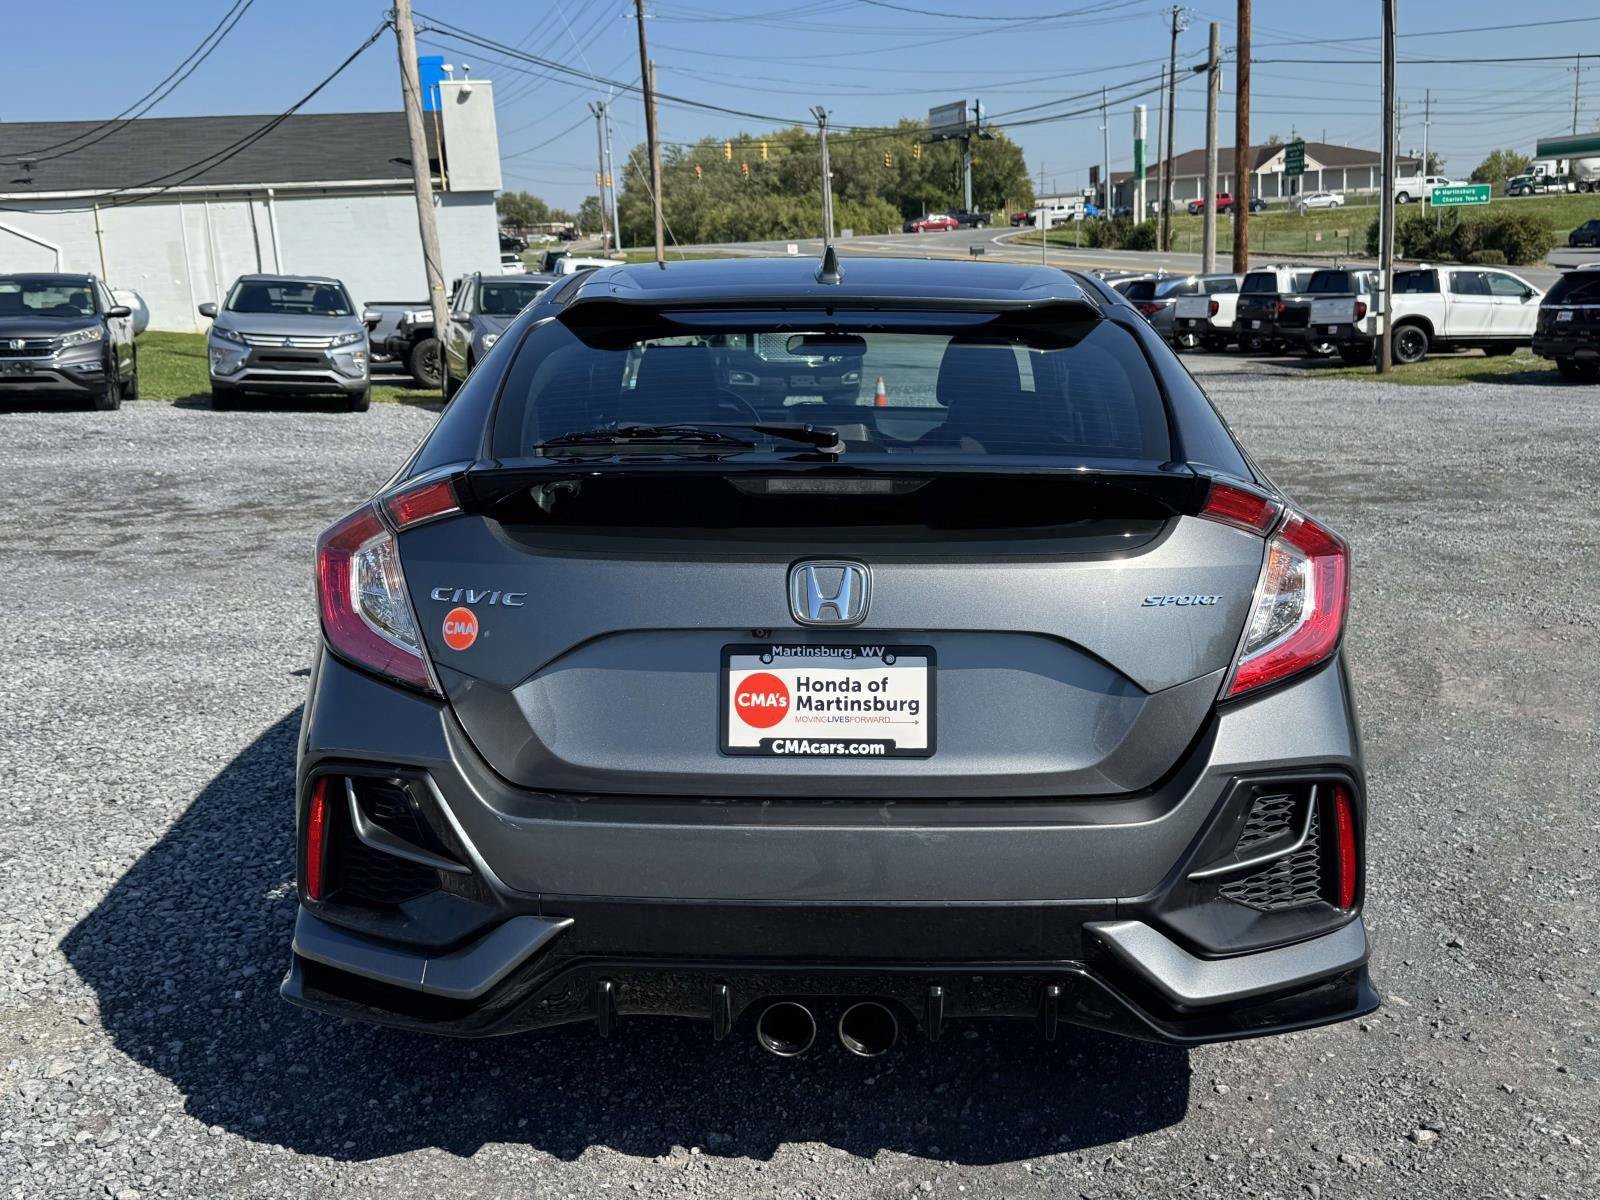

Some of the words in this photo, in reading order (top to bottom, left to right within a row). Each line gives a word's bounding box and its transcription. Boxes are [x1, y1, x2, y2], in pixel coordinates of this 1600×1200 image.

[430, 587, 528, 606] CIVIC
[1141, 594, 1224, 607] SPORT
[444, 621, 475, 635] CMA
[772, 646, 856, 659] Martinsburg,
[861, 646, 885, 657] WV
[796, 677, 861, 692] Honda
[867, 677, 889, 692] of
[738, 692, 787, 708] CMA's
[796, 695, 920, 715] Martinsburg
[772, 740, 885, 755] CMAcars.com
